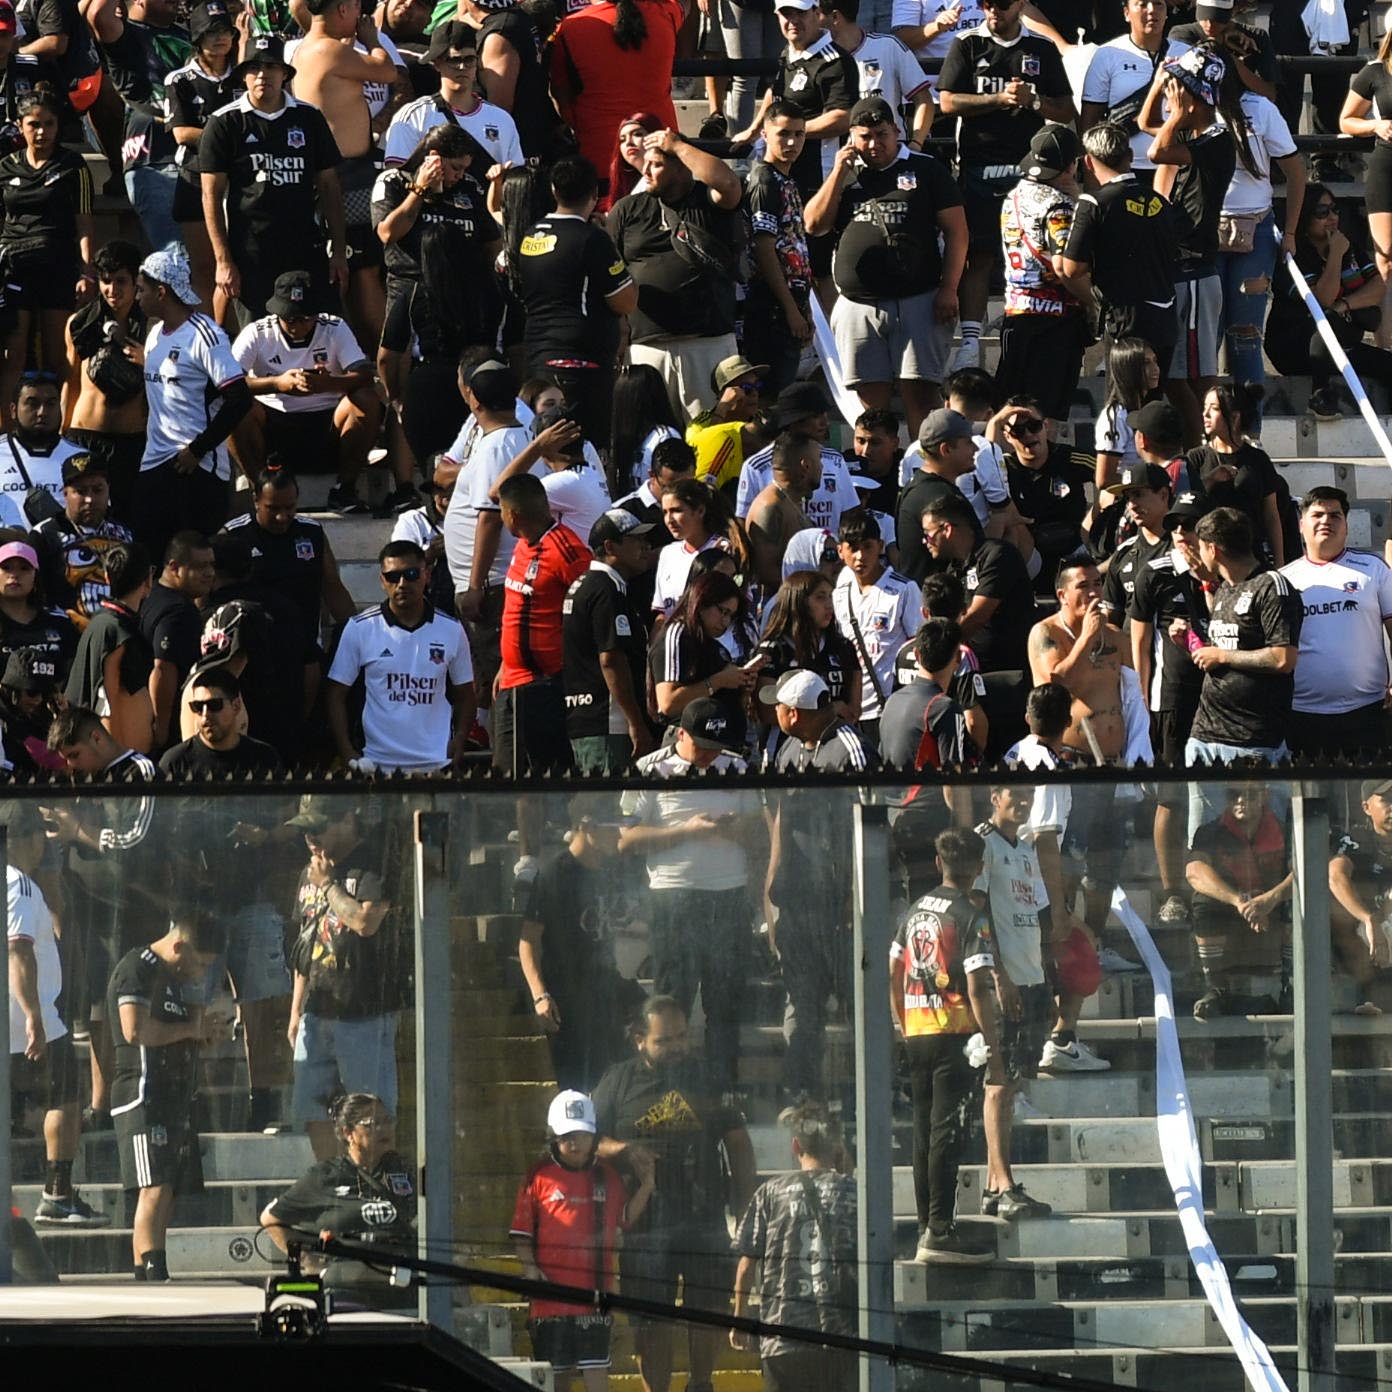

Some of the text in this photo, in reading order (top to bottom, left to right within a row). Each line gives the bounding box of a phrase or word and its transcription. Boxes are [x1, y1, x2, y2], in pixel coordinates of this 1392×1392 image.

[251, 154, 305, 172] Pilsen
[275, 170, 304, 186] Sur
[386, 670, 438, 690] Pilsen
[389, 688, 435, 706] del Sur
[918, 895, 953, 914] JEAN
